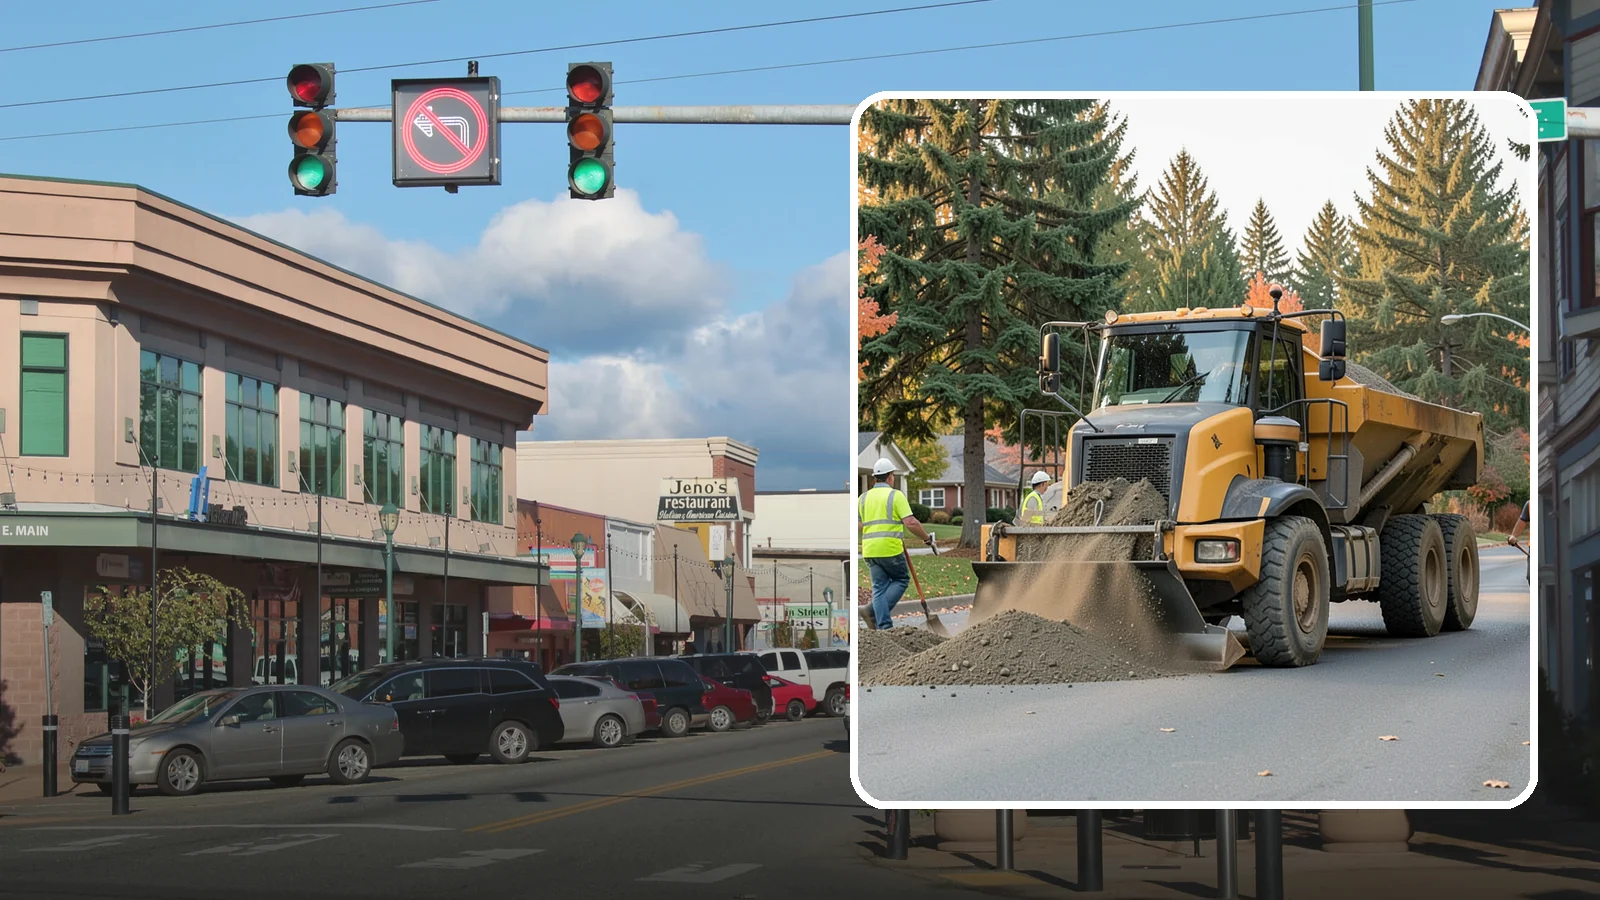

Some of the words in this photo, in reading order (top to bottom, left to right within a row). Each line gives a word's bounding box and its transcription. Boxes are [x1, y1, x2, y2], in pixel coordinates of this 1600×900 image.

[670, 480, 727, 494] Jeno's
[665, 496, 730, 509] restaurant
[659, 510, 681, 520] Italian
[686, 510, 714, 519] American
[715, 510, 737, 520] Cuisine
[2, 526, 13, 536] E.
[16, 526, 48, 536] MAIN
[798, 608, 828, 616] Street
